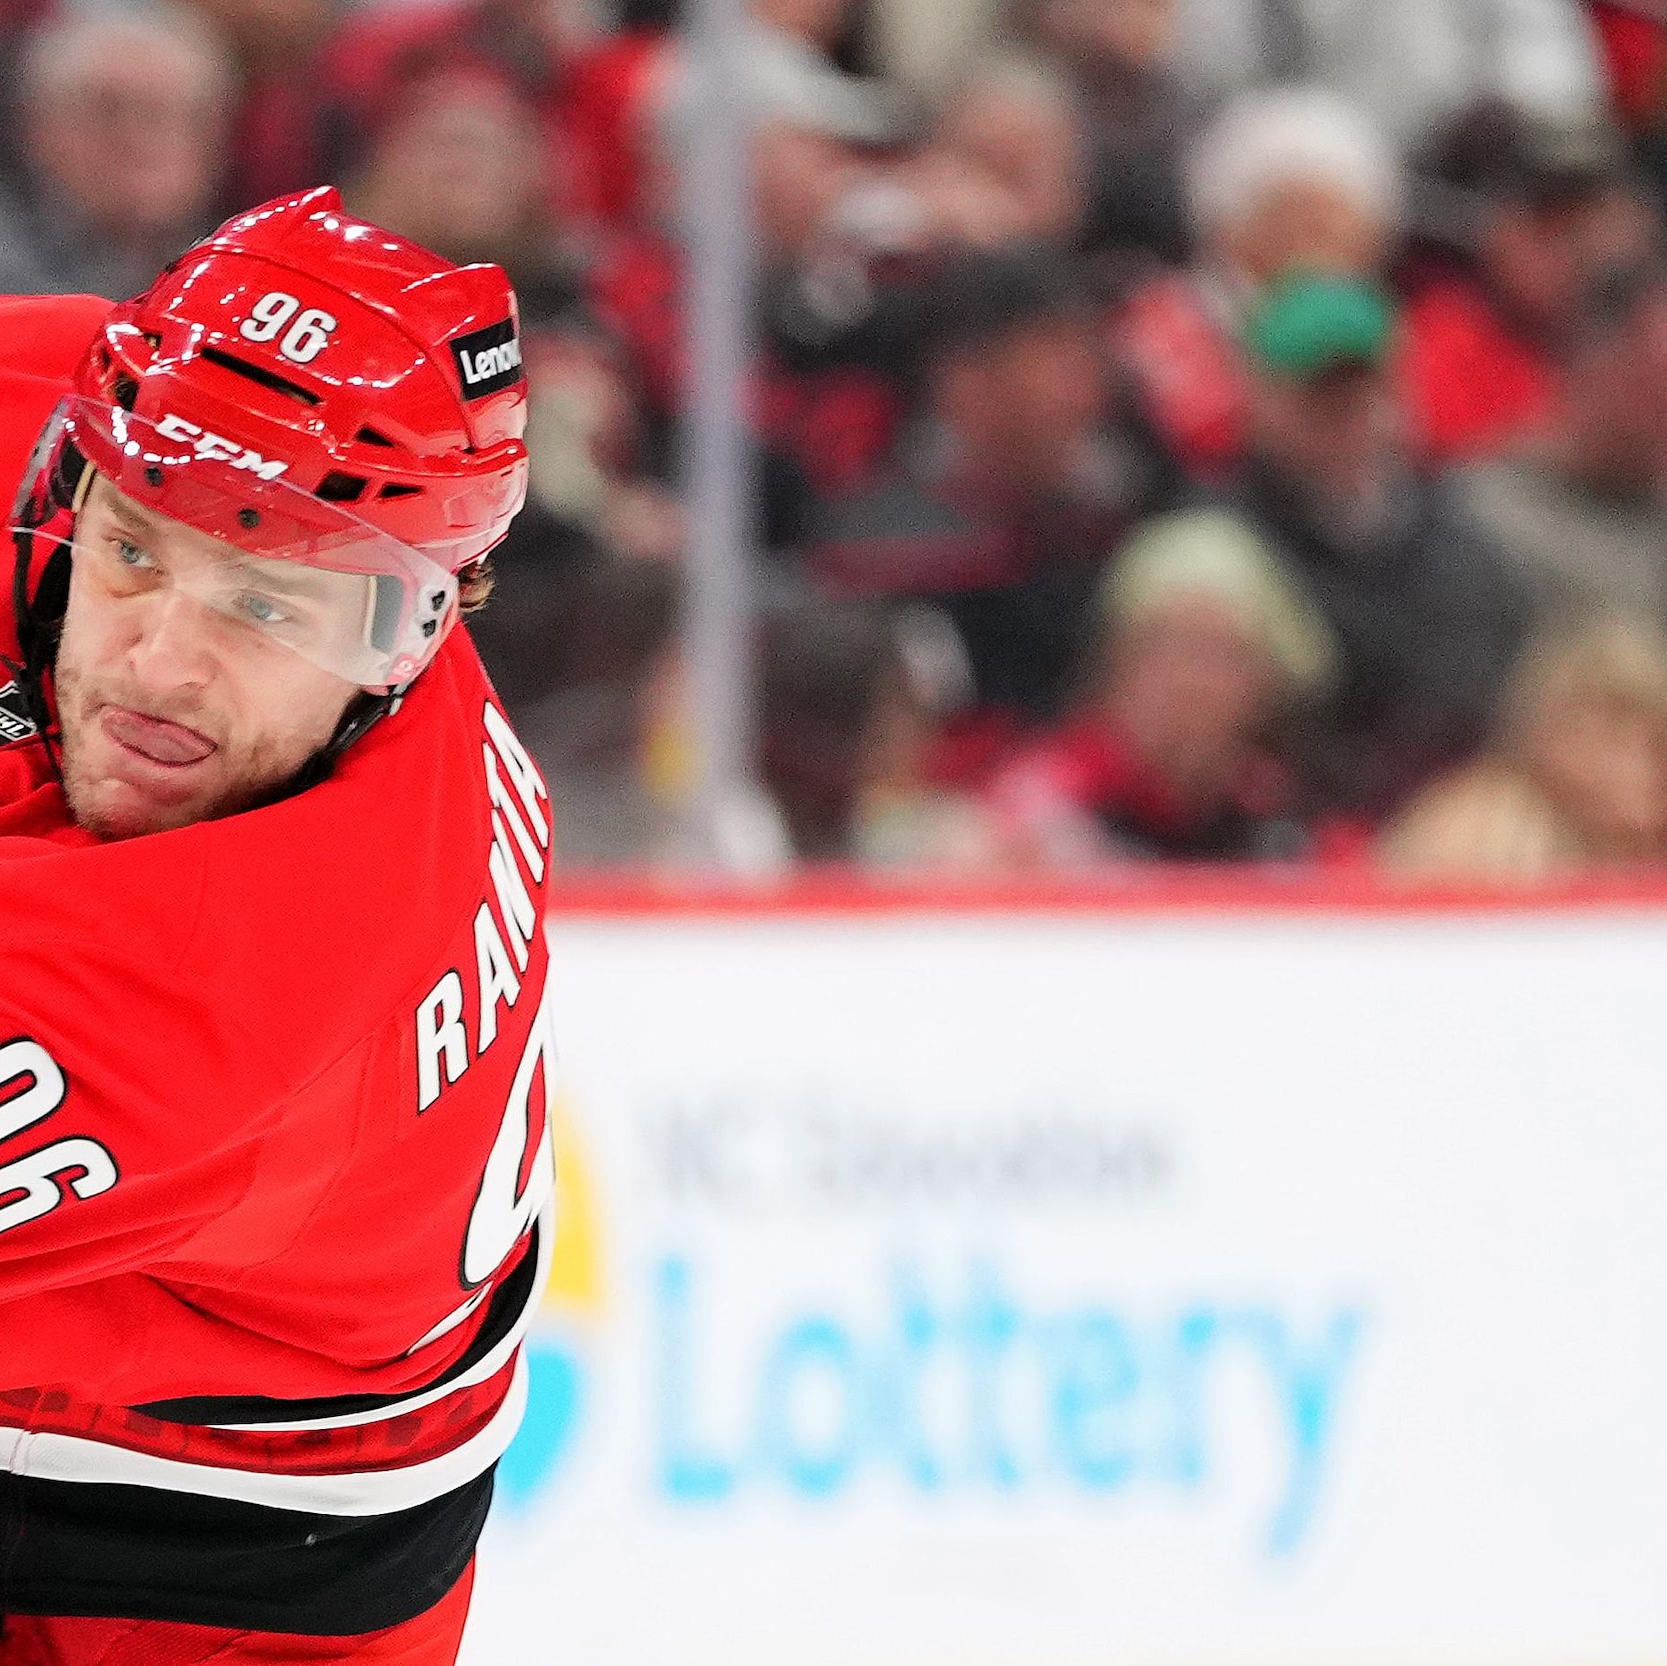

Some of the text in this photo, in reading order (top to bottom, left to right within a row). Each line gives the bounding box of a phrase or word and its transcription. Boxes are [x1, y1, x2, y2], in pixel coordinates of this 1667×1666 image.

[239, 290, 338, 364] 96
[156, 413, 289, 480] CCM
[653, 1245, 1369, 1562] Lottery
